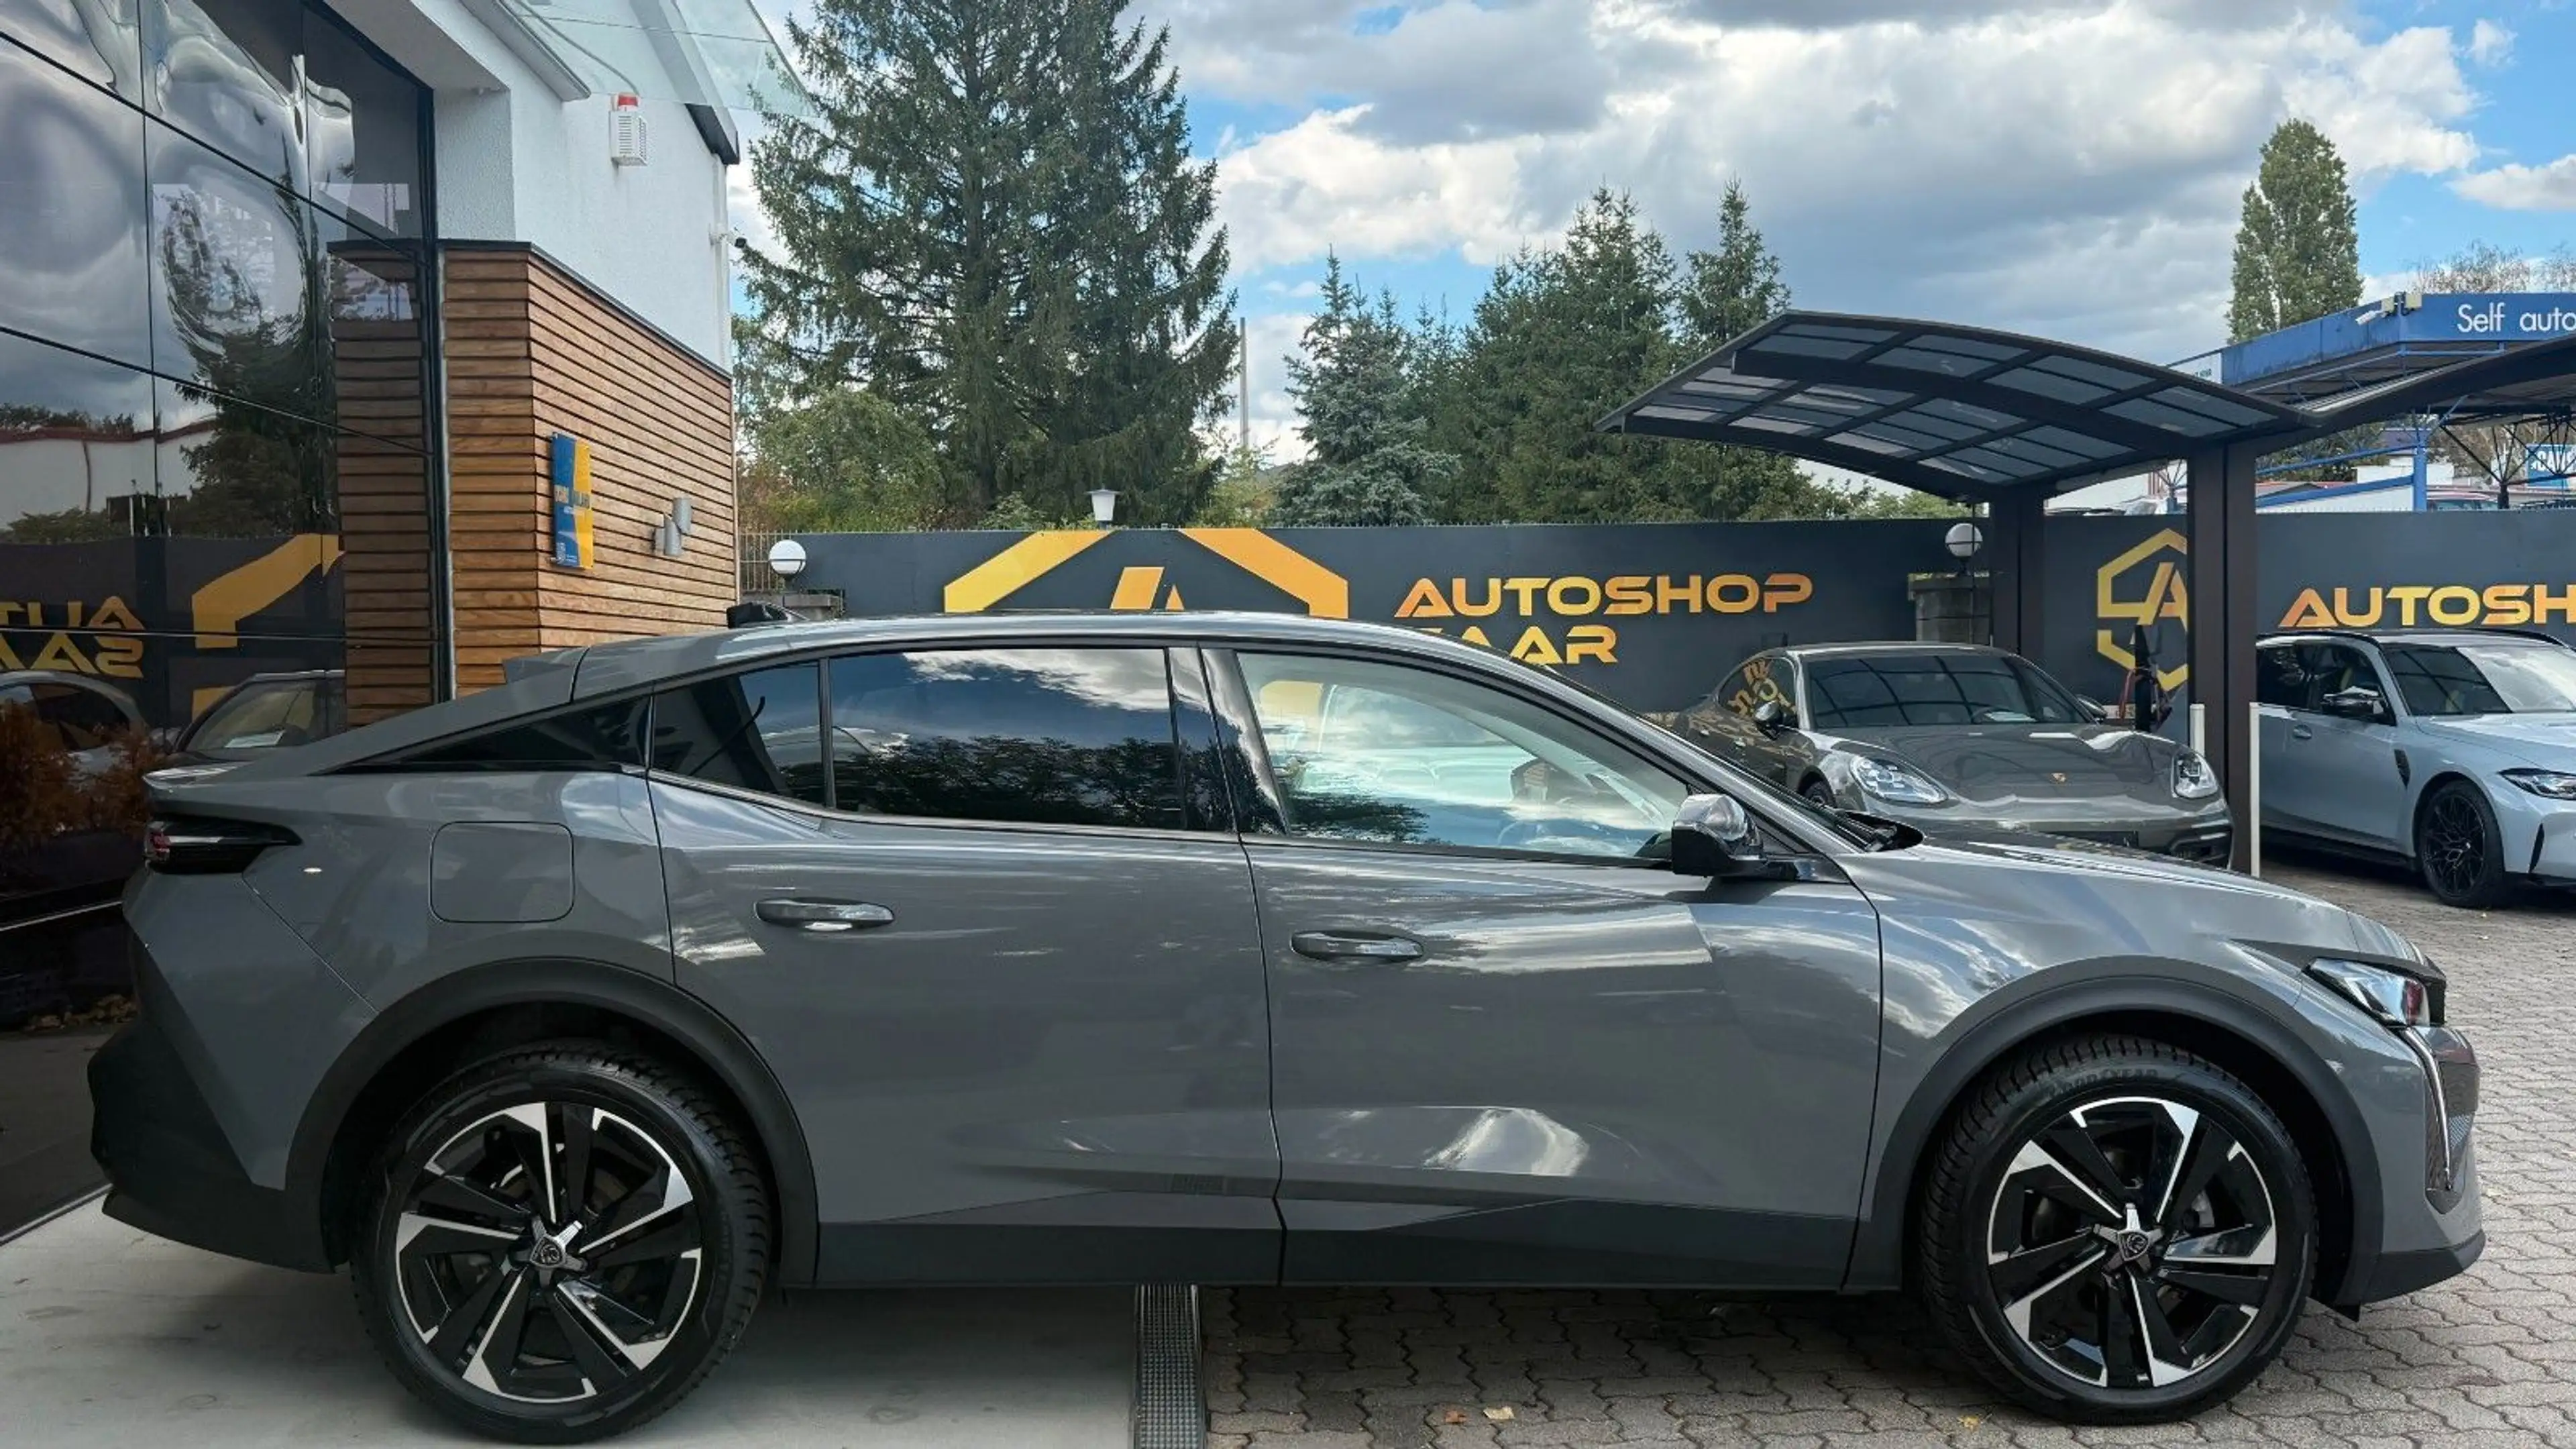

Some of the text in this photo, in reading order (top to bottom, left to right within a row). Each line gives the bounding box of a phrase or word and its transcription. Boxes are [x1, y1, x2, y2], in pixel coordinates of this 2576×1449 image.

[2457, 302, 2576, 333] Self auto
[1394, 573, 1813, 618] AUTOSHOP
[2277, 584, 2576, 628] AUTOSH
[1419, 625, 1619, 664] AR
